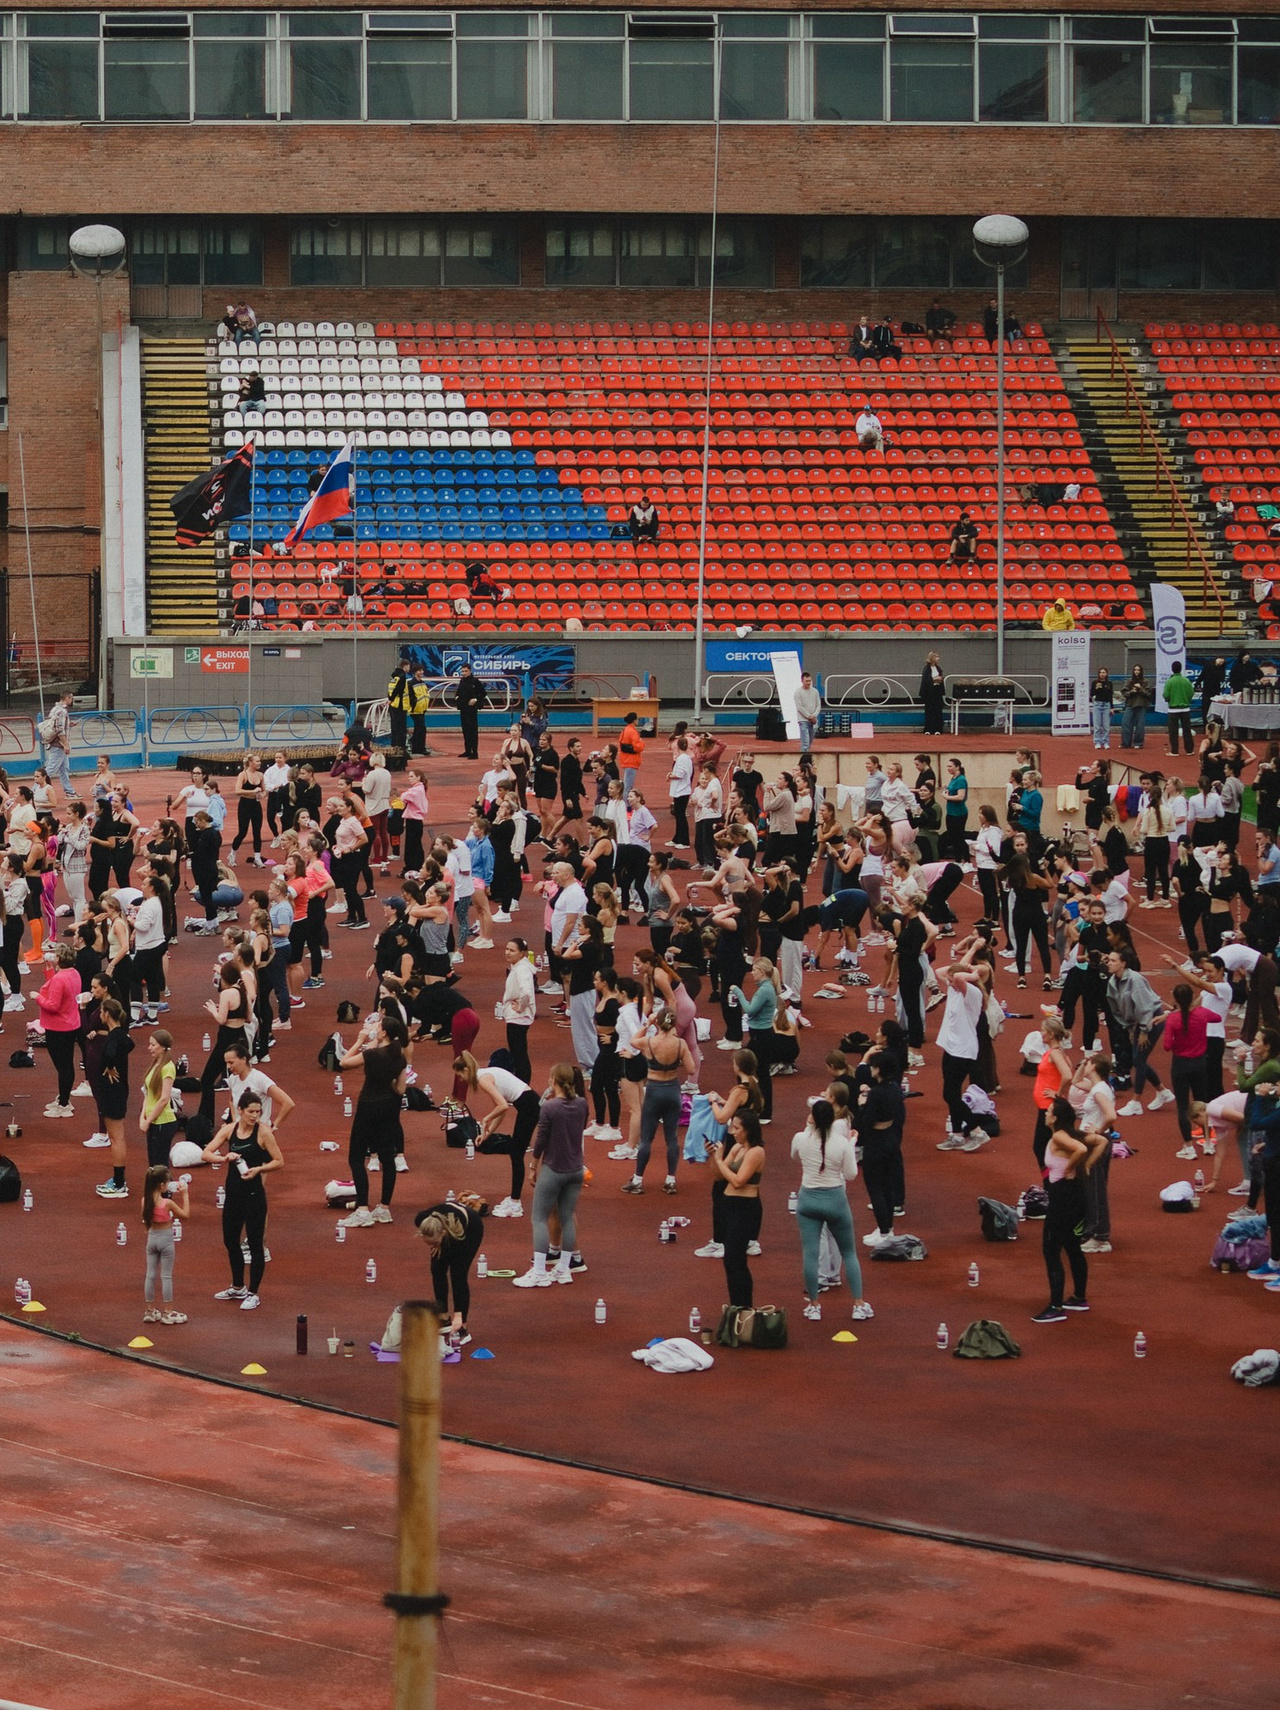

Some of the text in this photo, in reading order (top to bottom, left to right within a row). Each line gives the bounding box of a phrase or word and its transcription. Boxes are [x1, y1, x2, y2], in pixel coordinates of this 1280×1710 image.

[216, 650, 250, 659] ВЫХОД
[216, 662, 236, 670] EXIT
[472, 660, 531, 670] СИБИРЬ
